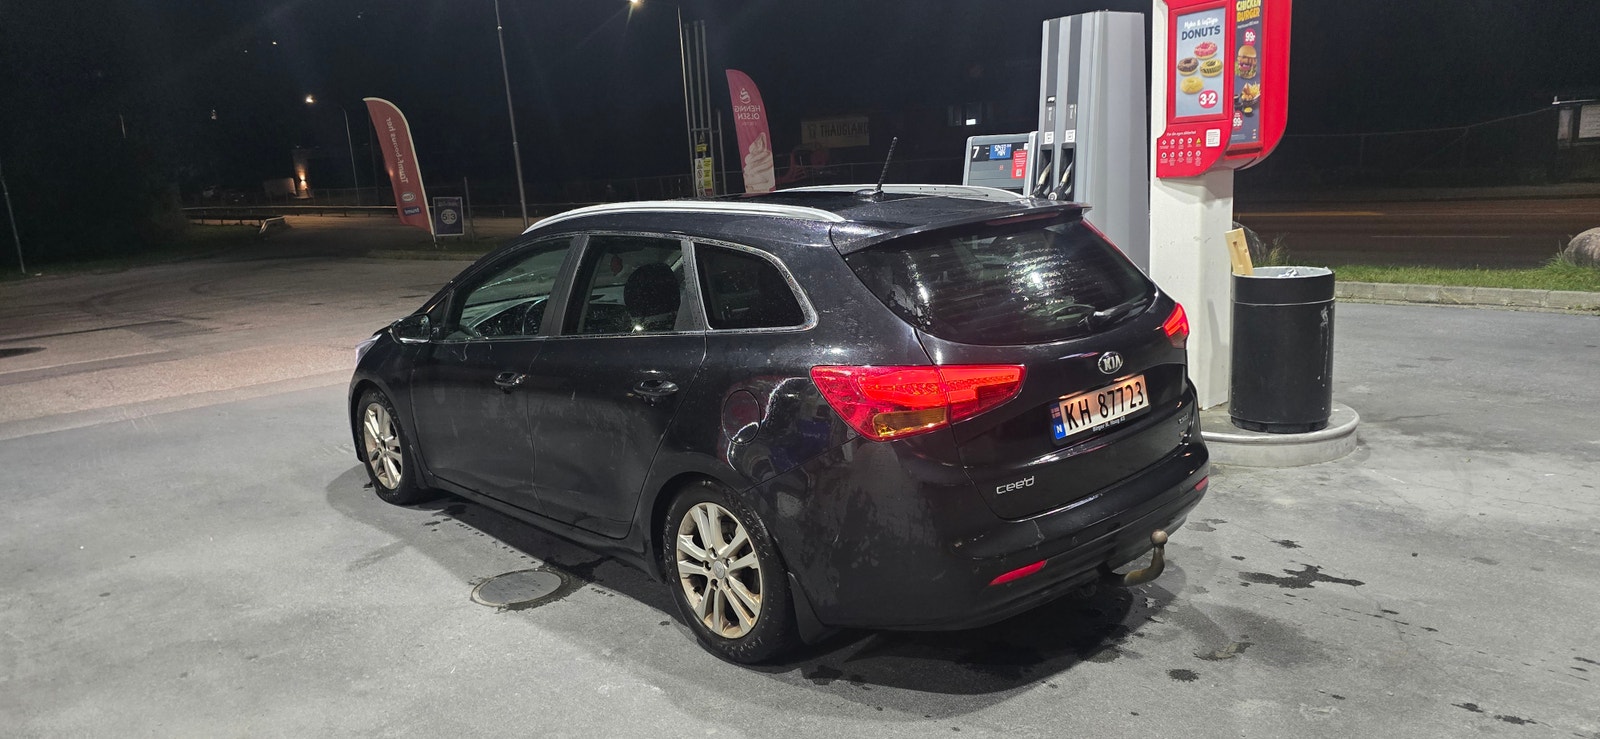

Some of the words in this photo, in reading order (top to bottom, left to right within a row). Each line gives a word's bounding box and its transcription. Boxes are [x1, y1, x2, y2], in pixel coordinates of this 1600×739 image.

[1236, 7, 1260, 23] BURGER
[1182, 25, 1220, 40] DONUTS
[972, 146, 980, 159] 7
[1103, 355, 1121, 371] KIA
[1064, 399, 1092, 430] KH
[1098, 381, 1145, 418] 87723
[1056, 425, 1063, 434] N
